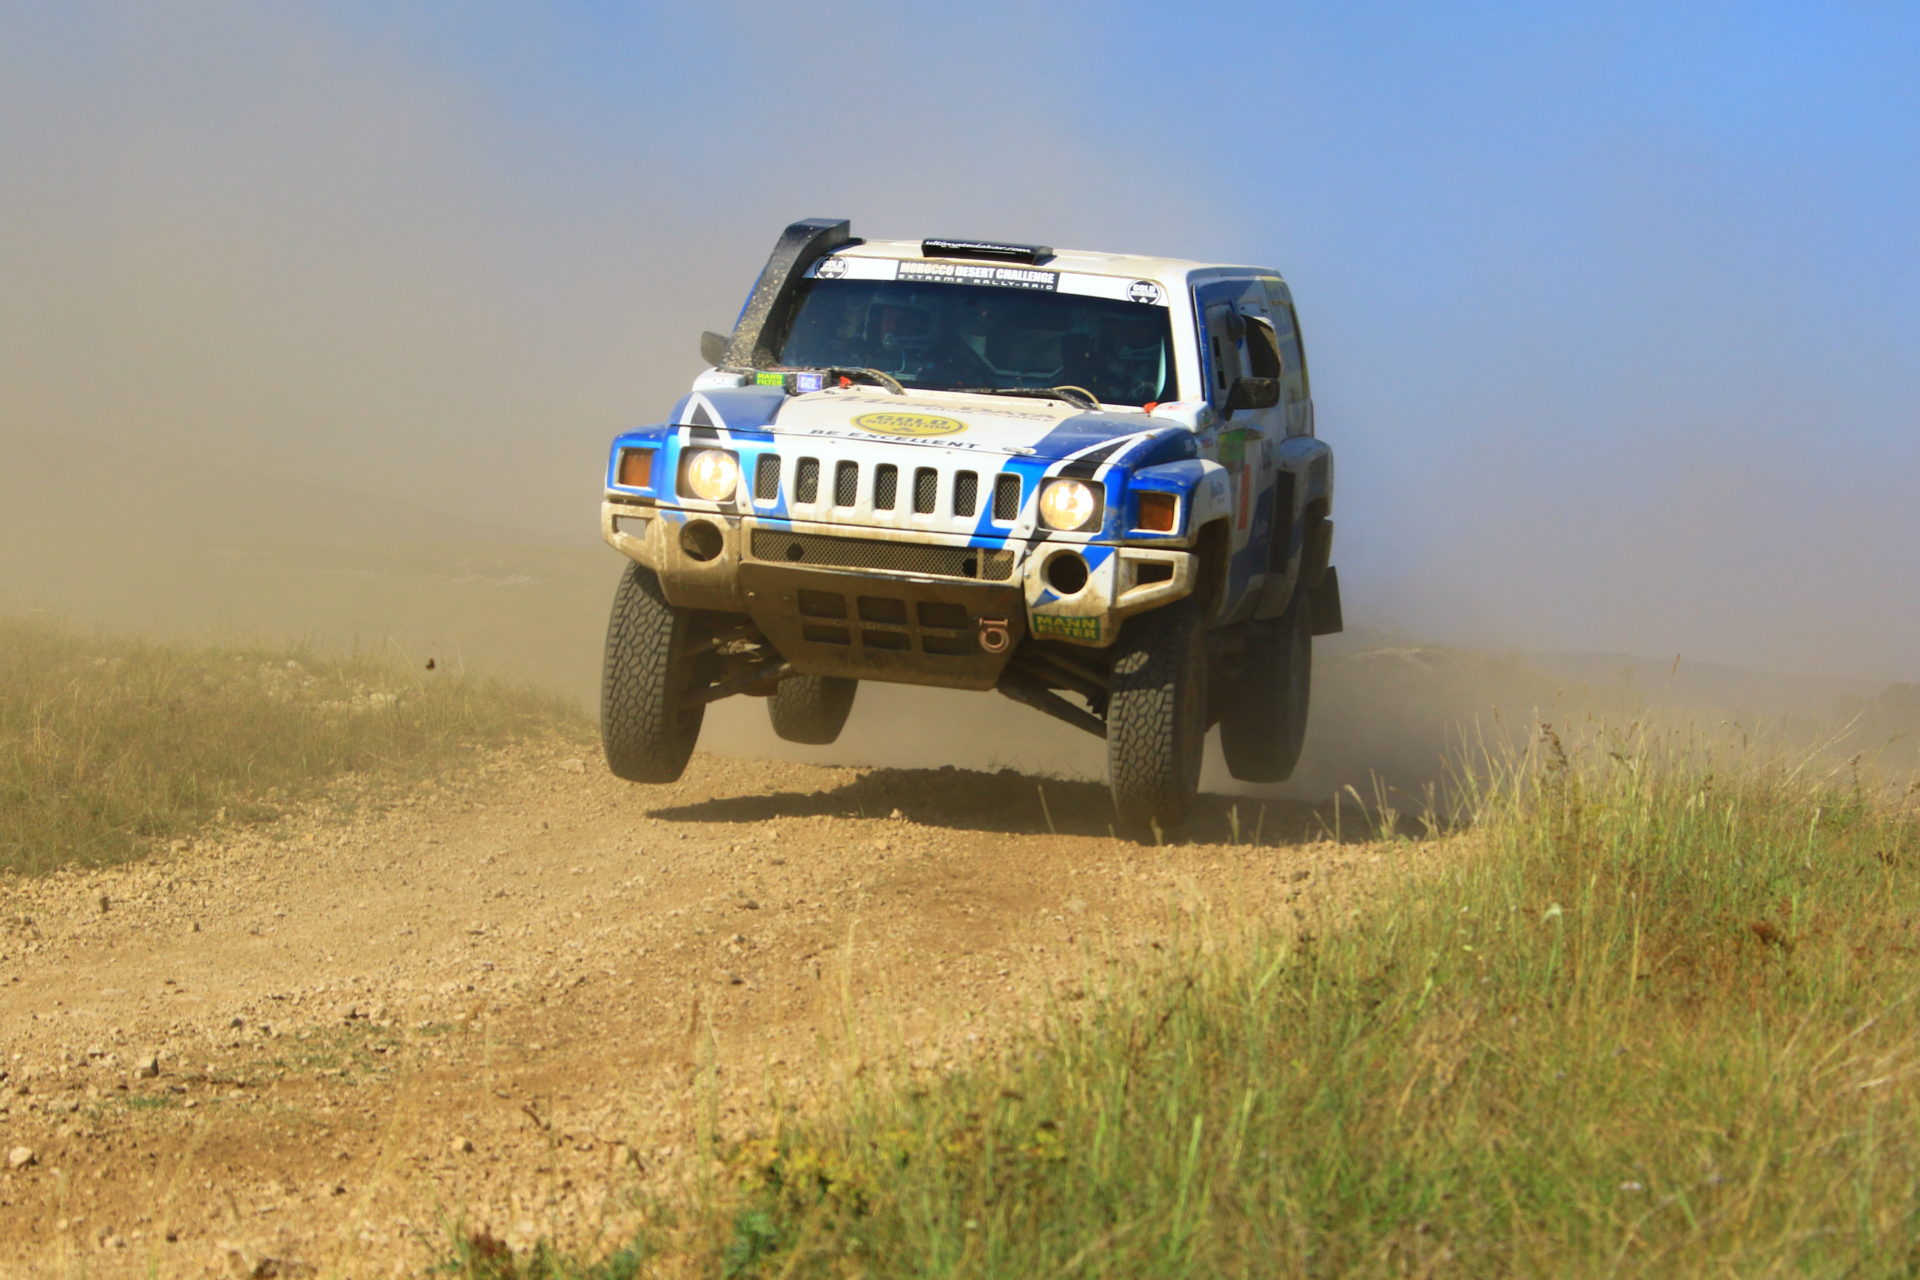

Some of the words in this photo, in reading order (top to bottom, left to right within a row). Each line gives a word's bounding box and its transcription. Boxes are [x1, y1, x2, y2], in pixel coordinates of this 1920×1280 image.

[900, 262, 954, 275] MOROCCO
[955, 265, 995, 279] DESERT
[995, 268, 1055, 283] CHALLENGE
[898, 274, 965, 283] EXTREME
[973, 279, 1054, 290] RALLY-RAID
[865, 419, 951, 430] NUTRITION
[876, 415, 949, 425] GOLD
[848, 432, 981, 449] EXCELLENT
[1037, 616, 1096, 628] MANN
[1038, 624, 1097, 638] FILTER
